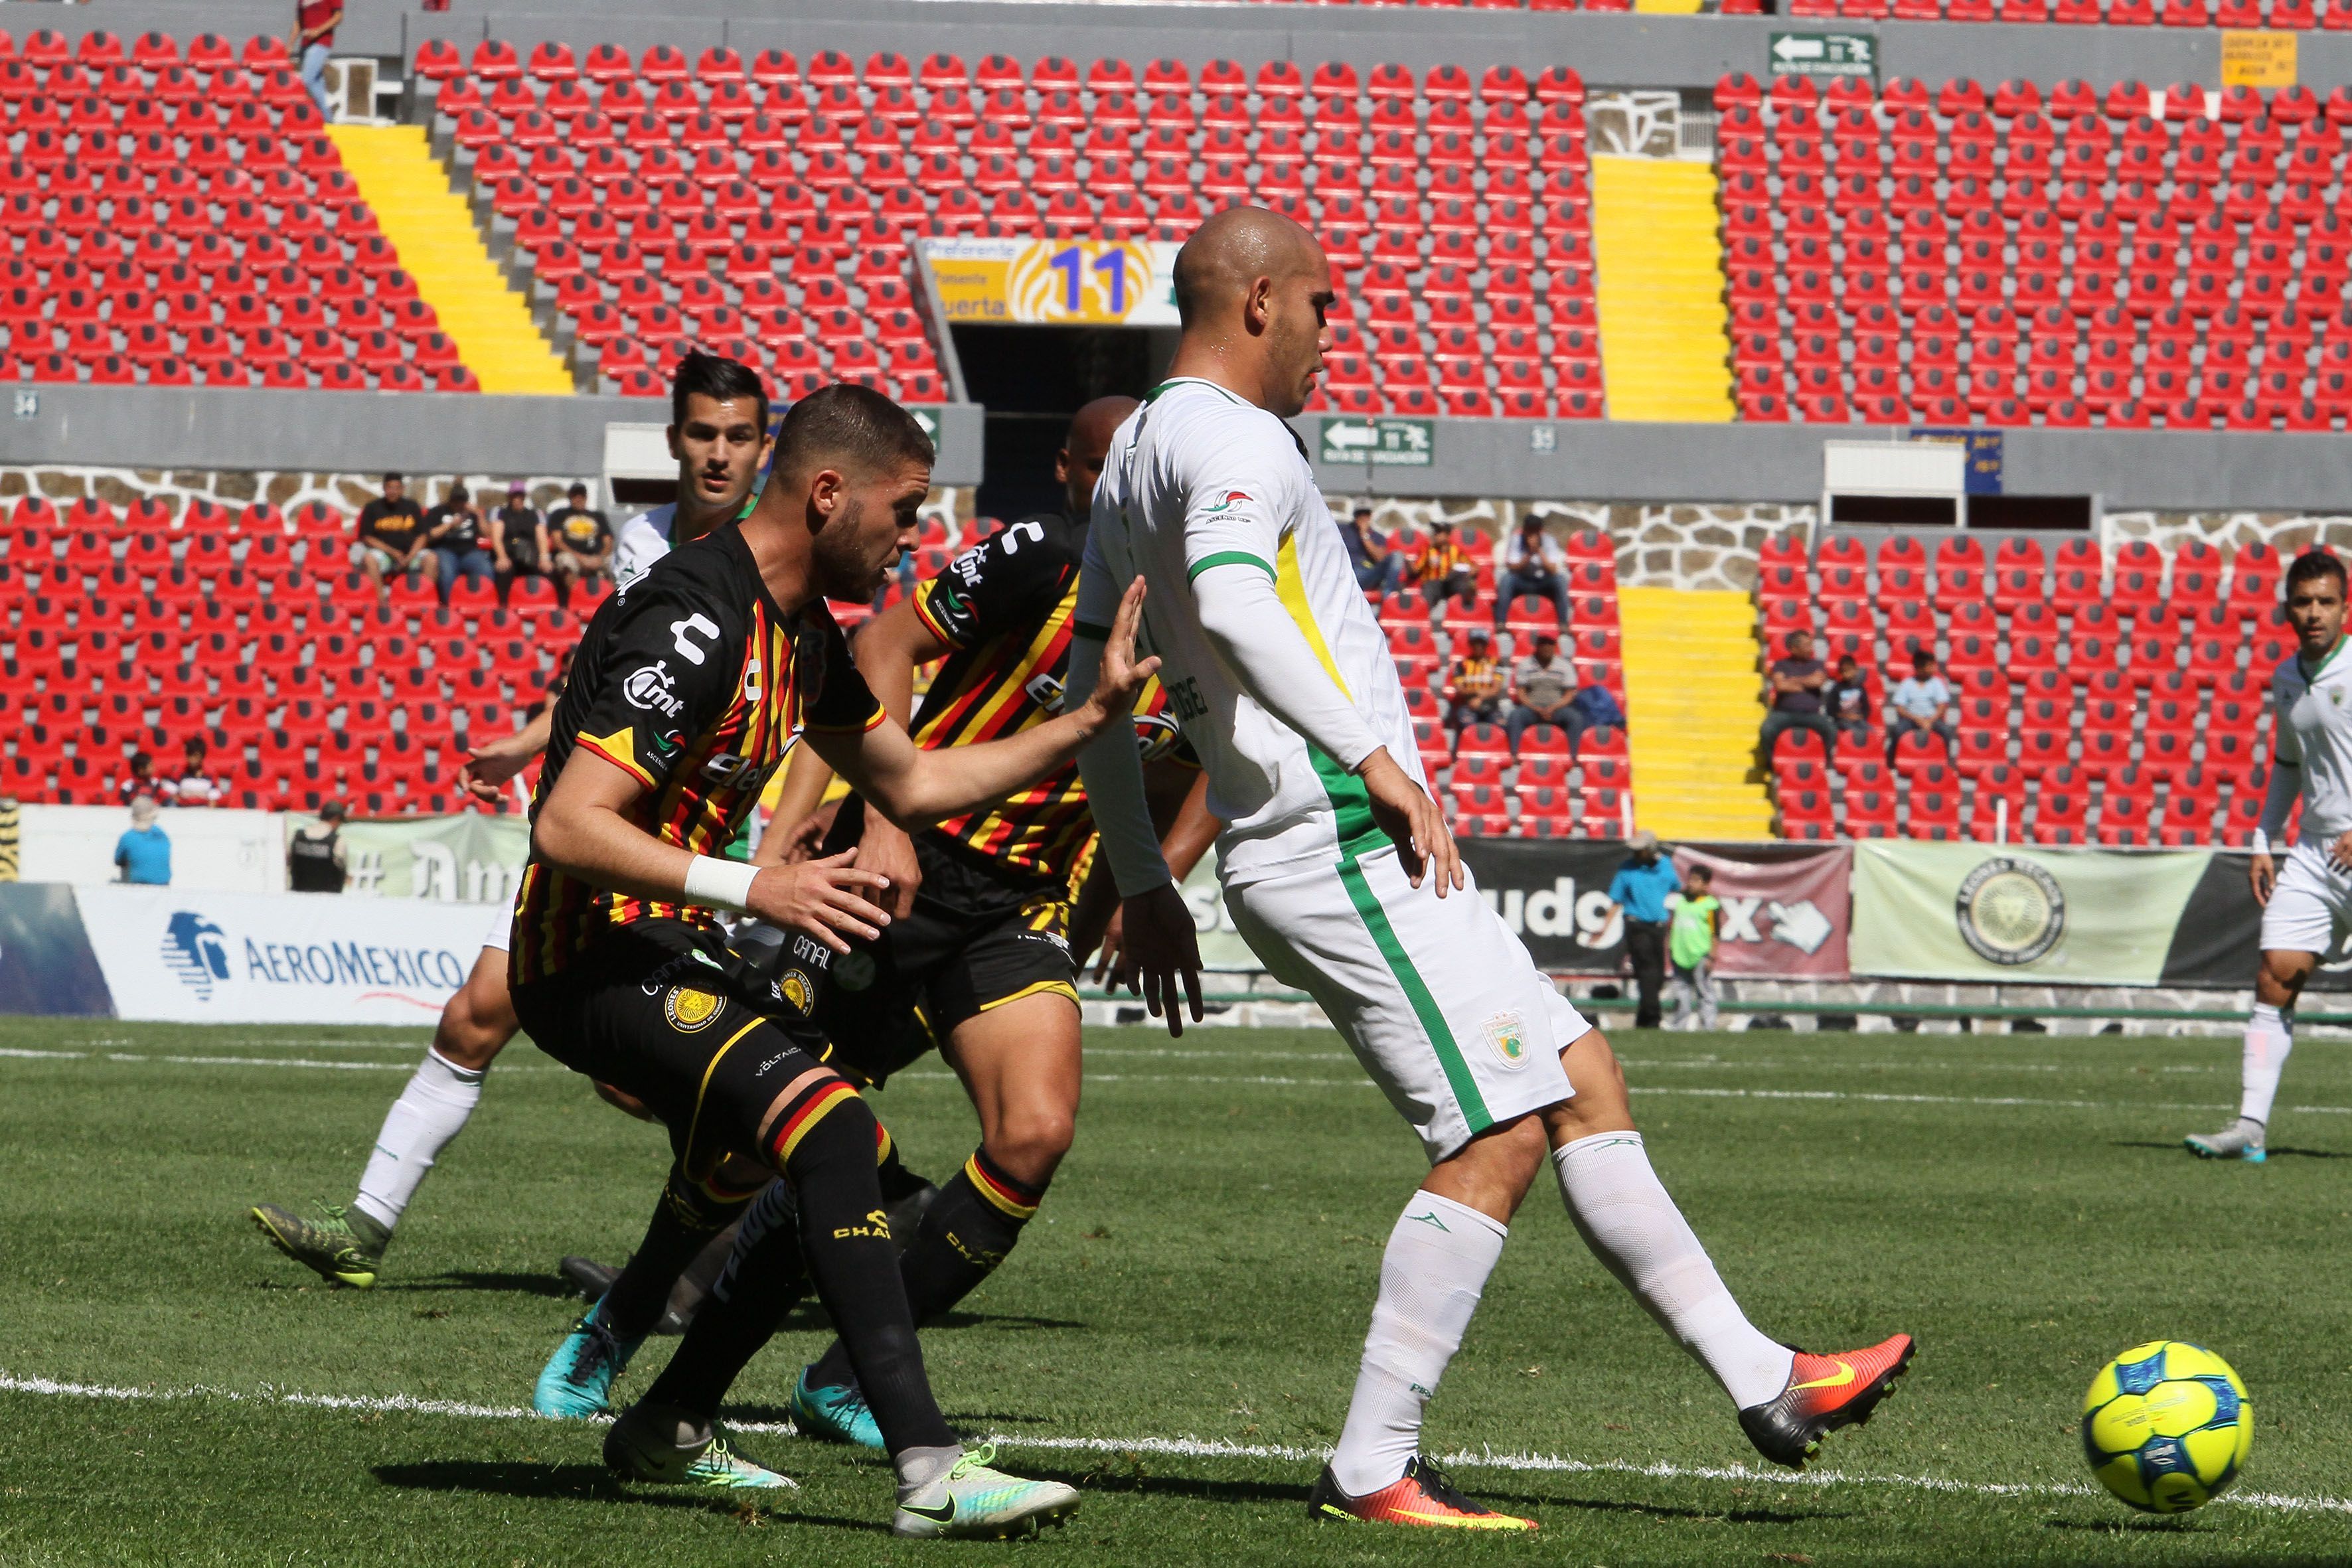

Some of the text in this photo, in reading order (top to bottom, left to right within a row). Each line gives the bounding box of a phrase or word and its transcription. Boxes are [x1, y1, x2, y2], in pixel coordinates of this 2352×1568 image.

[1050, 246, 1124, 313] 11
[667, 989, 679, 1022] LEONES
[676, 1020, 707, 1030] UNIVERSIDAD
